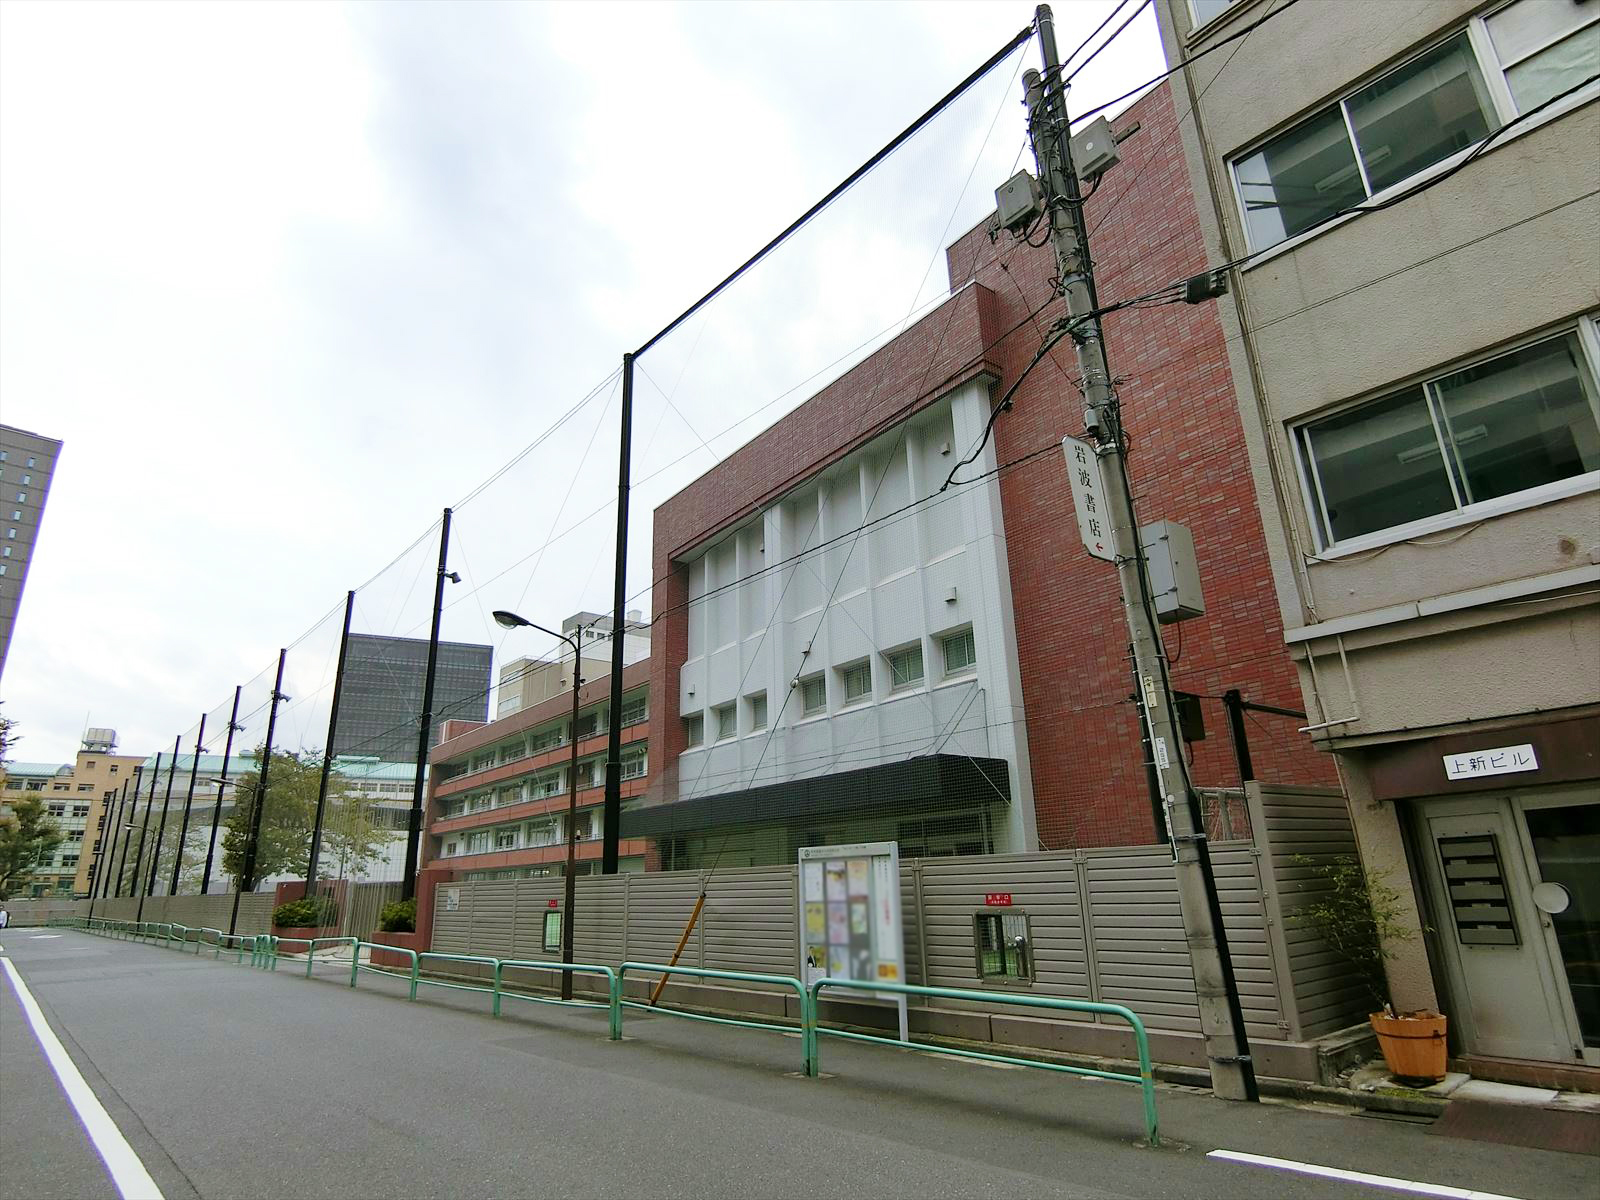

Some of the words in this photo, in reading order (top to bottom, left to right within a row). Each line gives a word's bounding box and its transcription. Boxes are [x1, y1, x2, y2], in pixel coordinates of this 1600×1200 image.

[1074, 445, 1101, 537] 岩波書店
[1452, 752, 1530, 774] 上新ビル
